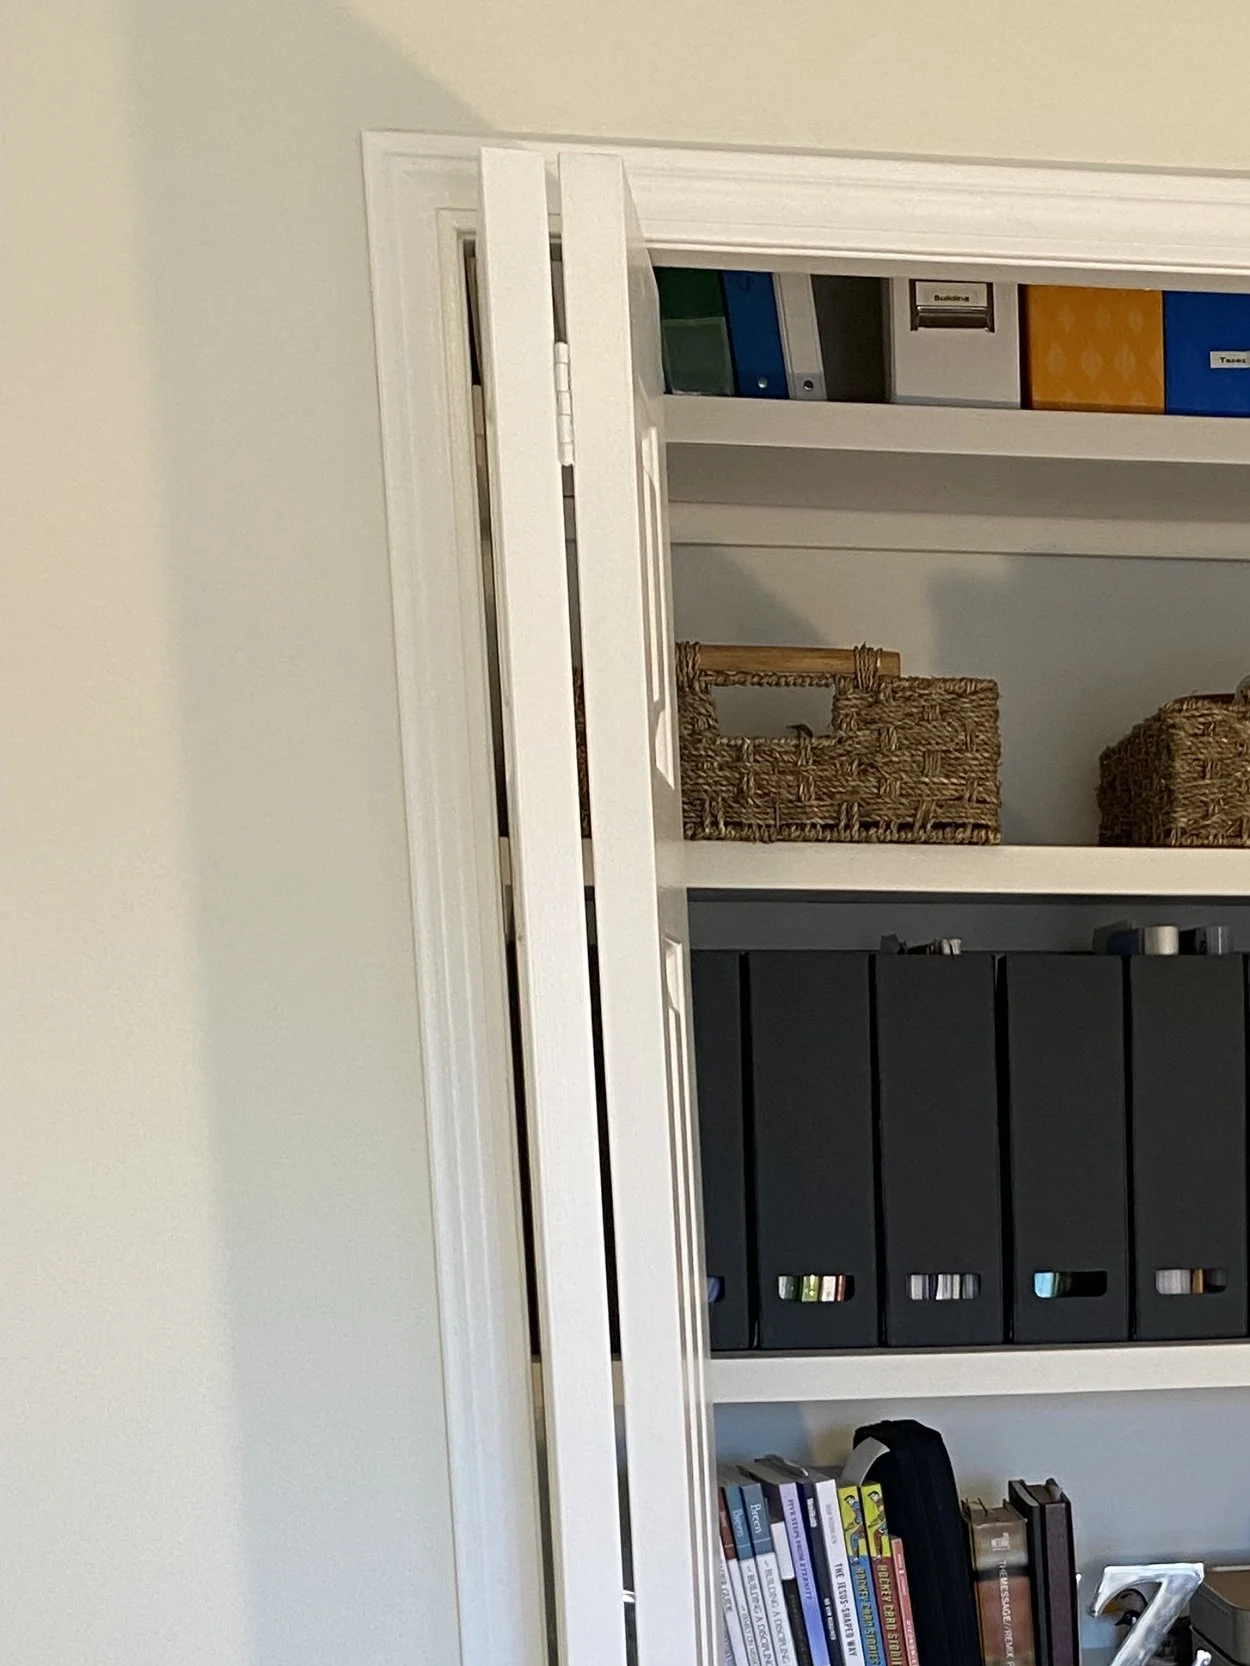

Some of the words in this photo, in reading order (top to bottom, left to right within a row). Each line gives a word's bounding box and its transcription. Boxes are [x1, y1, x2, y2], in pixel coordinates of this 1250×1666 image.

[732, 1508, 745, 1538] Breen
[750, 1503, 763, 1534] Breen
[786, 1499, 796, 1517] FIVE
[790, 1517, 801, 1539] STEPS
[794, 1540, 805, 1562] FROM
[798, 1562, 812, 1600] ETERNITY
[833, 1563, 844, 1578] THE
[853, 1567, 870, 1601] HOCKEY
[875, 1564, 892, 1602] HOCKEY
[746, 1574, 762, 1613] BUILDING
[764, 1568, 779, 1608] BUILDING
[774, 1618, 790, 1663] DISCIPLING
[837, 1581, 855, 1638] JESUS-SHAPED
[860, 1603, 874, 1627] CARD
[882, 1604, 897, 1630] CARD
[847, 1640, 858, 1657] WAY
[863, 1628, 881, 1665] STORIES
